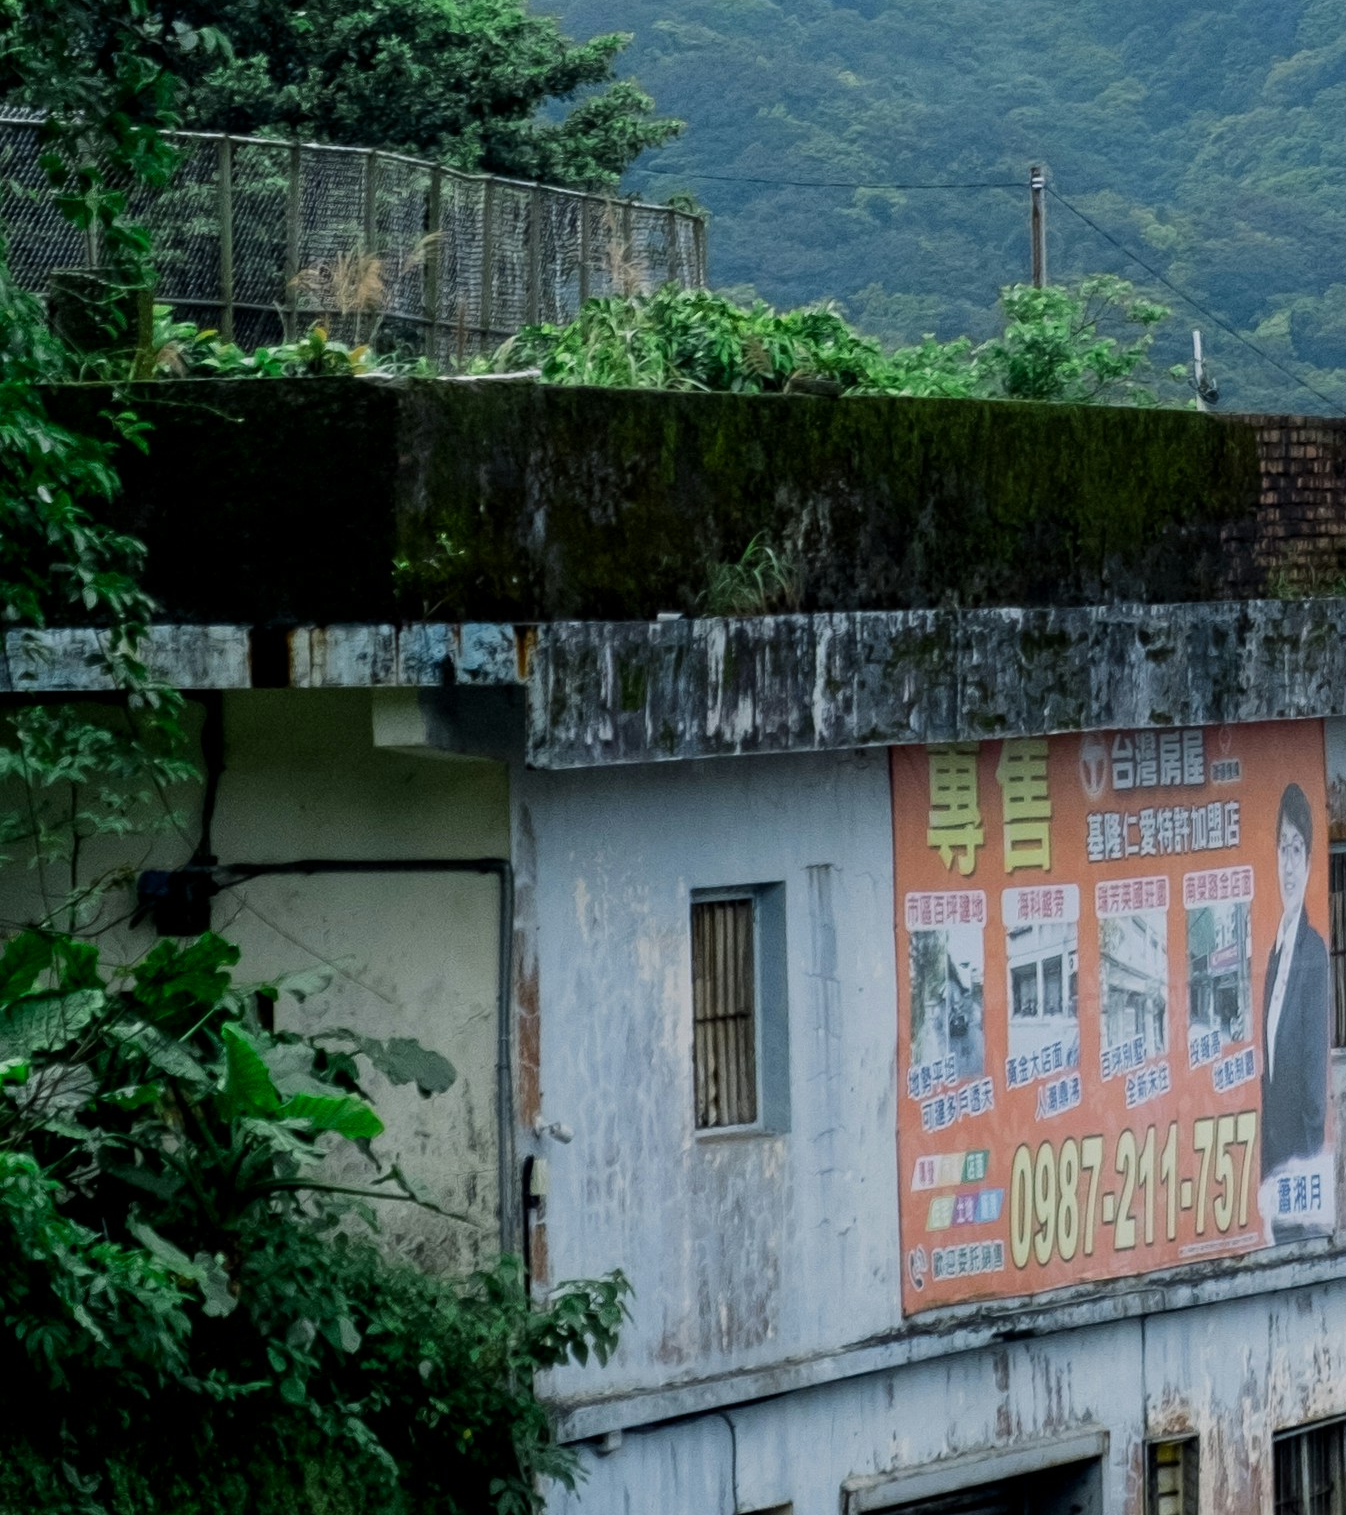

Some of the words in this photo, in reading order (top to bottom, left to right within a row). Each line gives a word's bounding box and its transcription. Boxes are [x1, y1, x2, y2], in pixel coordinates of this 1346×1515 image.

[1112, 729, 1205, 790] 台灣房屋
[1087, 800, 1240, 863] 基隆仁愛特許加盟店
[1010, 1109, 1257, 1269] 0987-211-757
